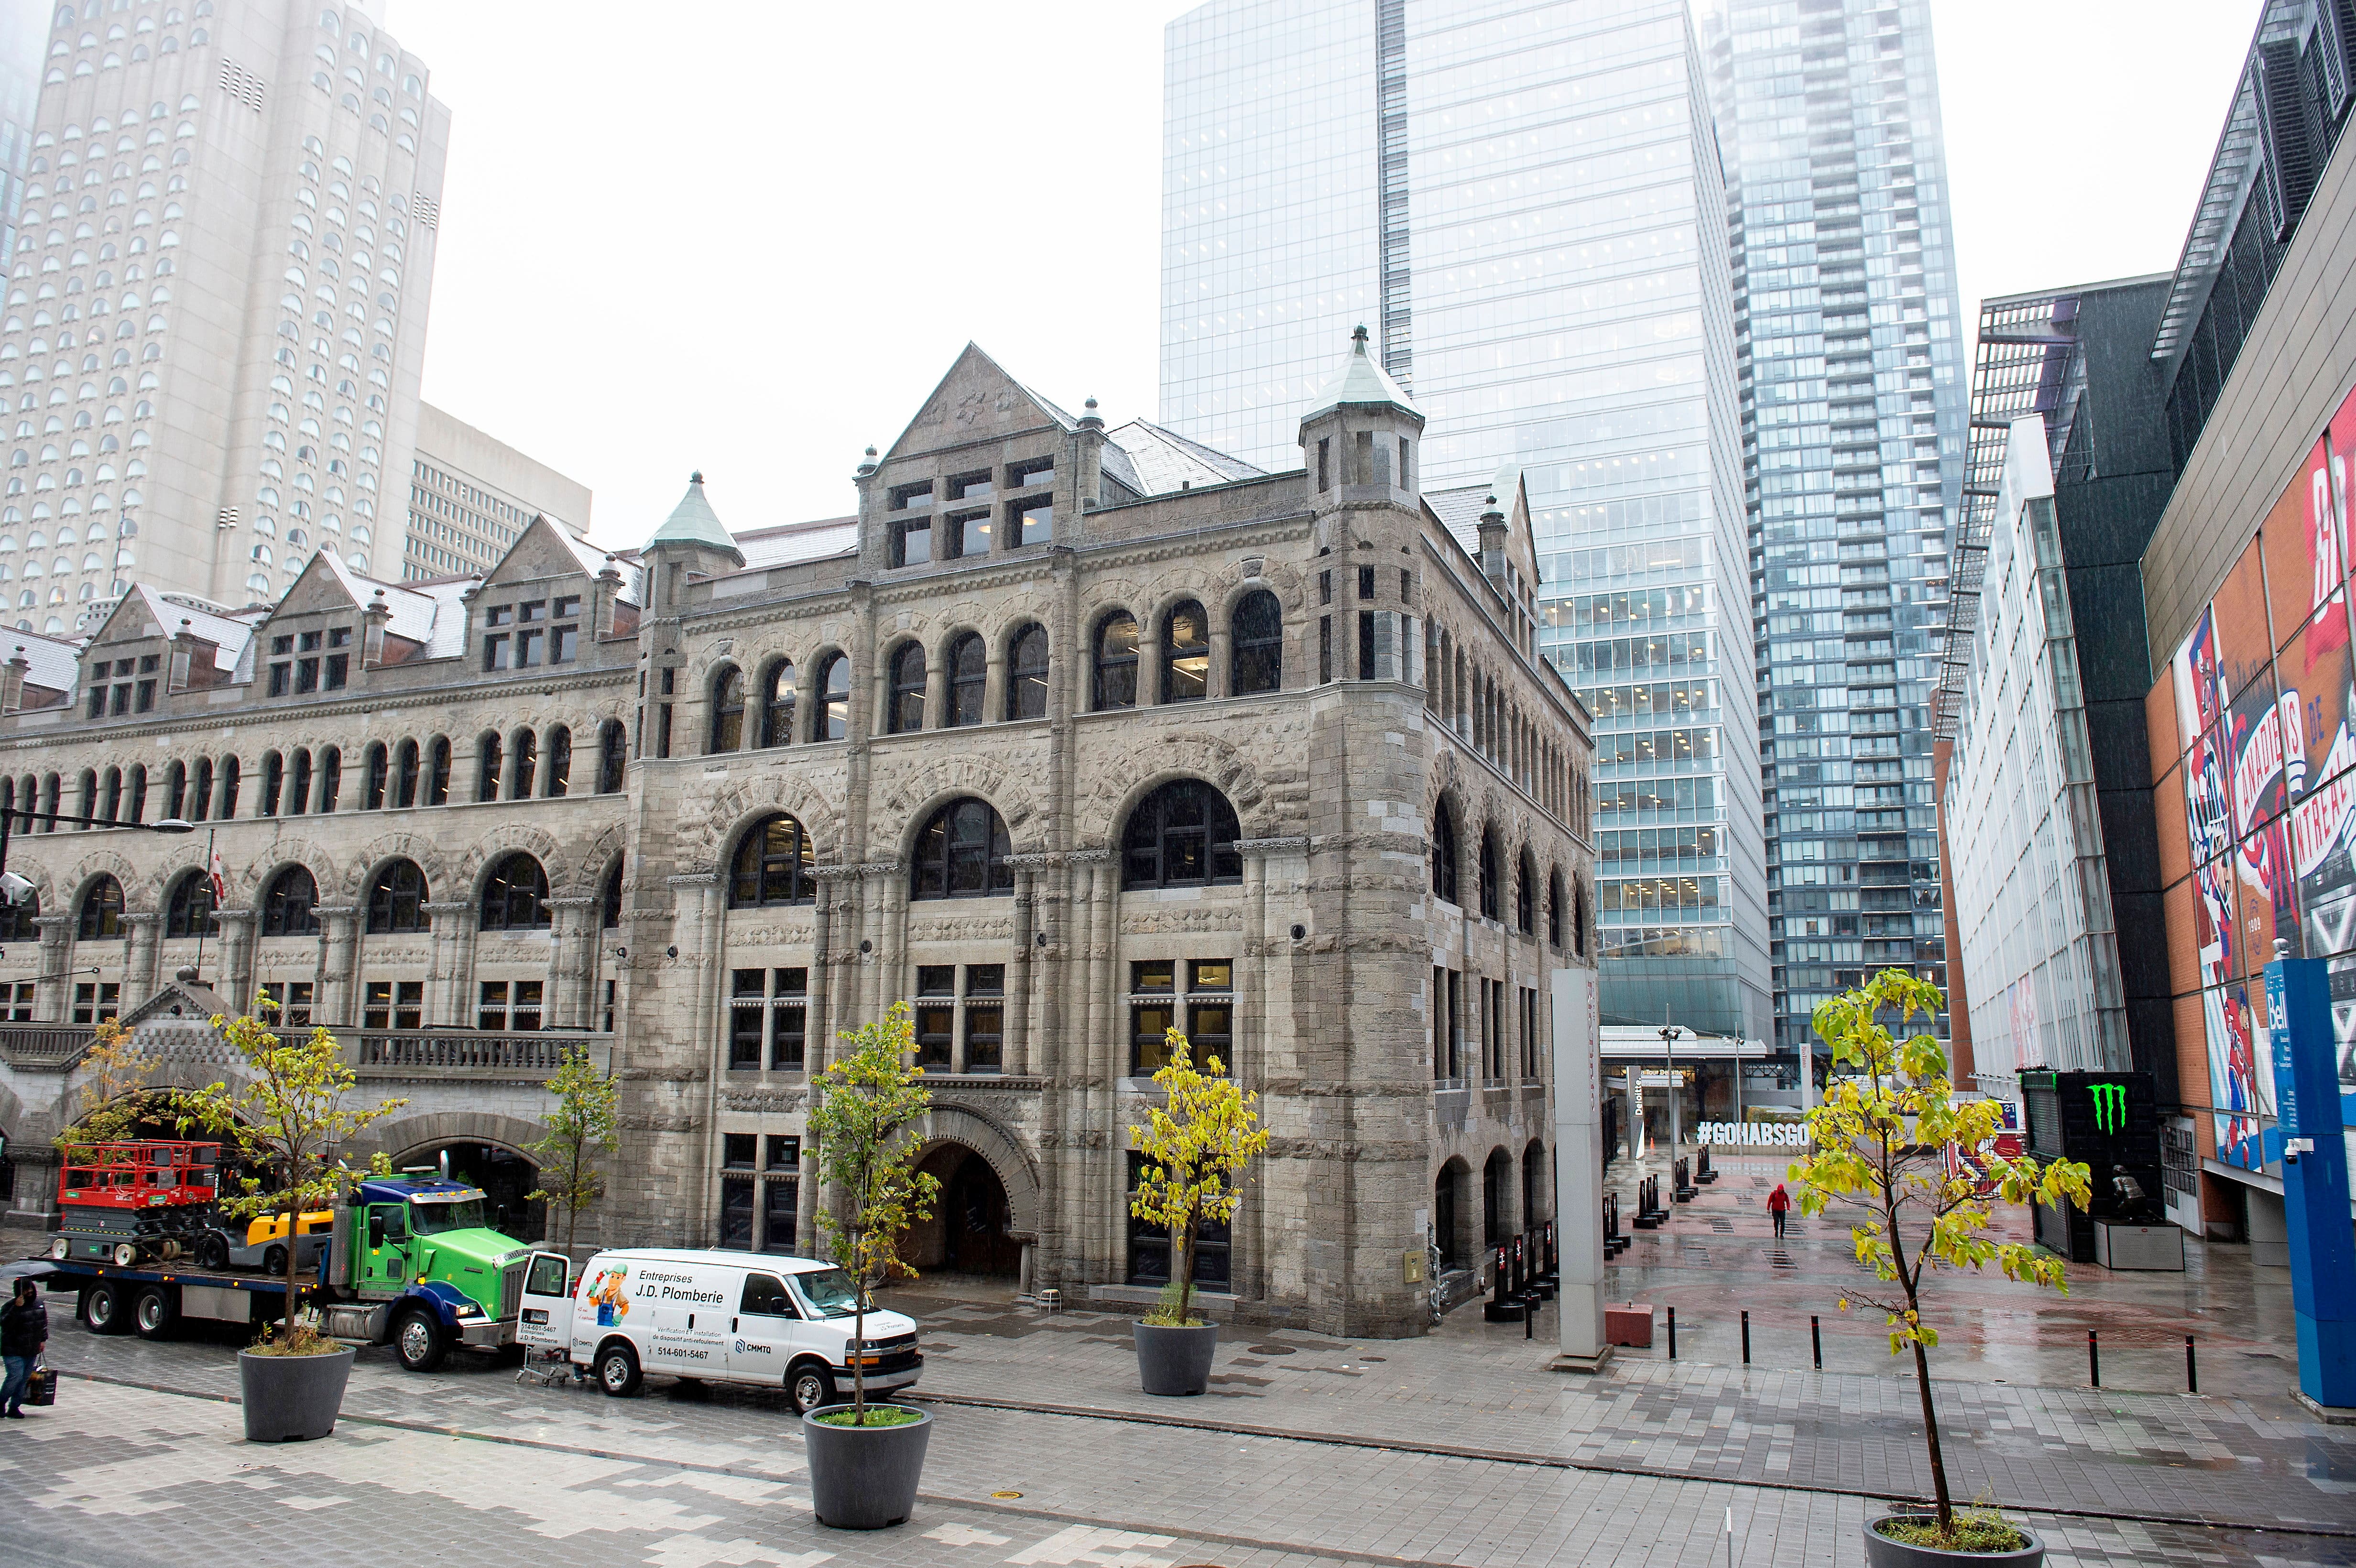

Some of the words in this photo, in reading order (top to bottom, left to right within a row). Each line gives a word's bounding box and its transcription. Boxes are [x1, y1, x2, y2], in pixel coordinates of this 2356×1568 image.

[2308, 695, 2324, 745] DE
[2248, 917, 2260, 932] 1909
[2267, 970, 2283, 990] Centre
[2267, 991, 2287, 1030] Bell
[1697, 1122, 1810, 1146] #GOHABSGO
[640, 1270, 693, 1283] Entreprises
[636, 1284, 658, 1297] J.D.
[662, 1286, 723, 1303] Plomberie
[522, 1324, 556, 1332] 514-601-5467
[531, 1336, 558, 1344] Plomberie
[658, 1347, 709, 1359] 514-601-5467
[747, 1344, 771, 1354] CMMTQ
